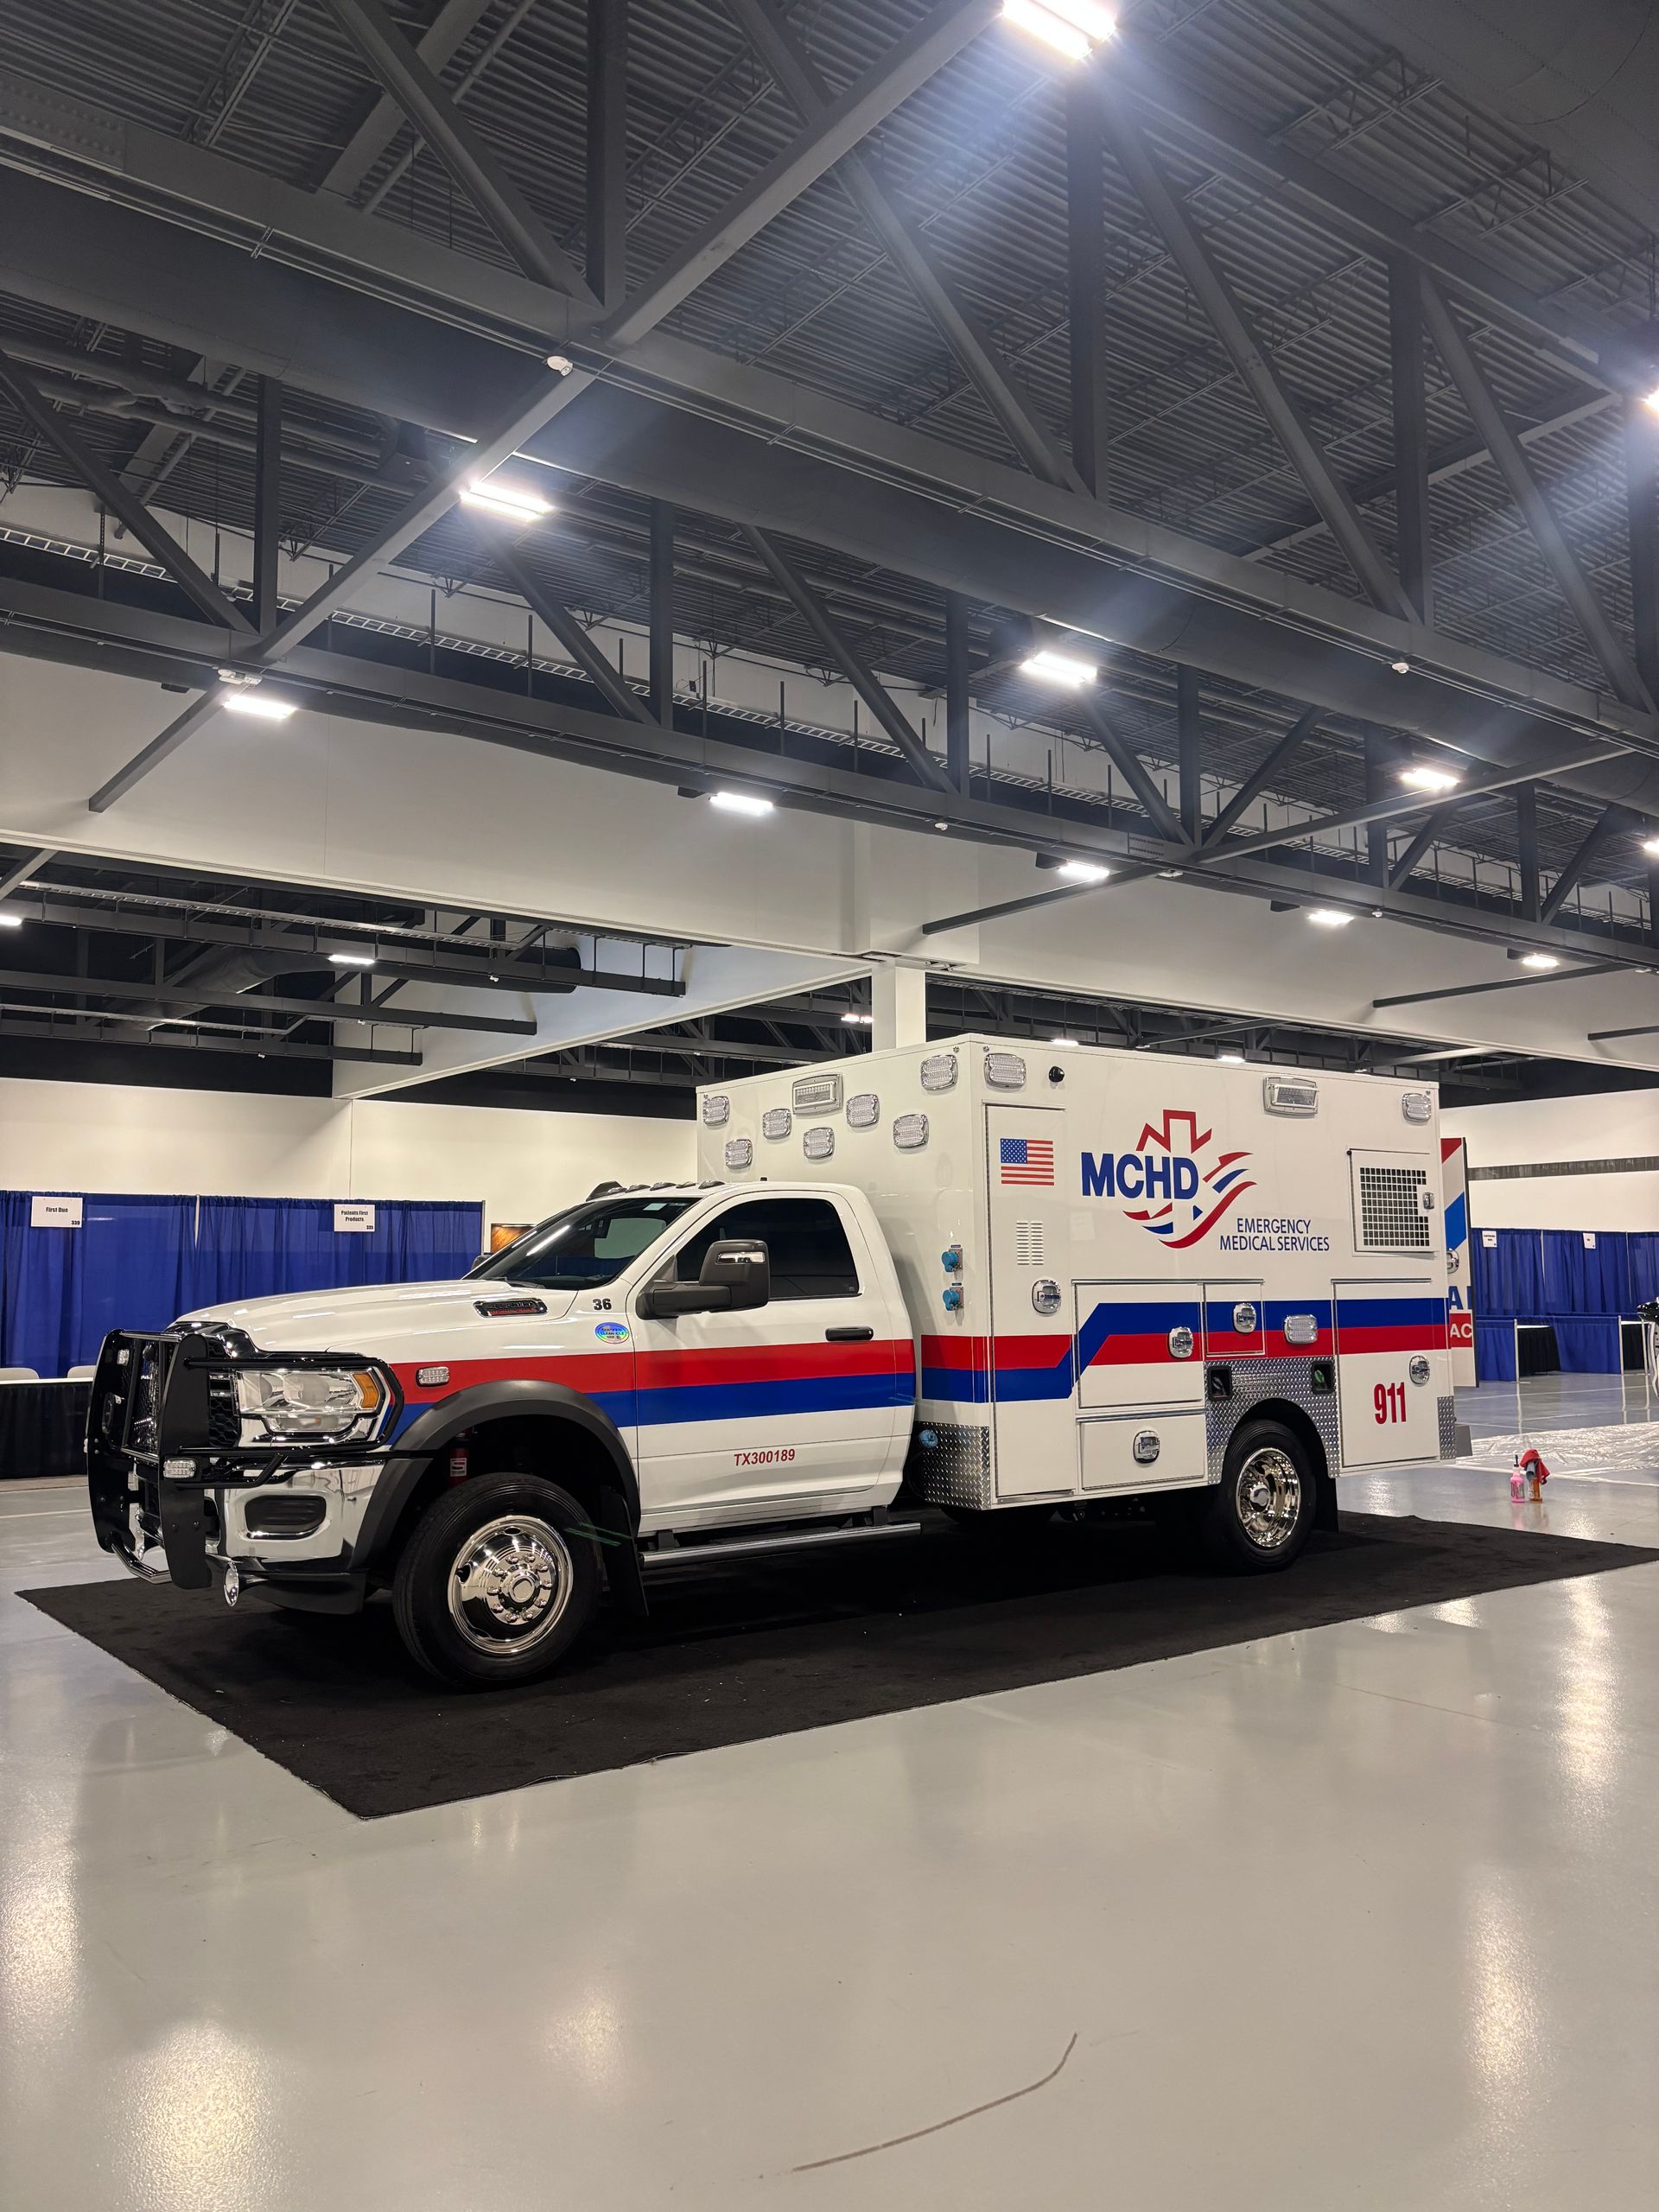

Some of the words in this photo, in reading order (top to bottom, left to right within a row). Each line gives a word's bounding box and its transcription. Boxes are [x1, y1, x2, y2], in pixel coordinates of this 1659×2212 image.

[1081, 1152, 1199, 1199] MCHD
[1237, 1217, 1312, 1234] EMERGENCY
[1219, 1235, 1275, 1251] MEDICAL
[1277, 1236, 1330, 1251] SERVICES
[593, 1298, 613, 1311] 36
[1374, 1382, 1407, 1425] 911
[734, 1449, 795, 1465] TX300189
